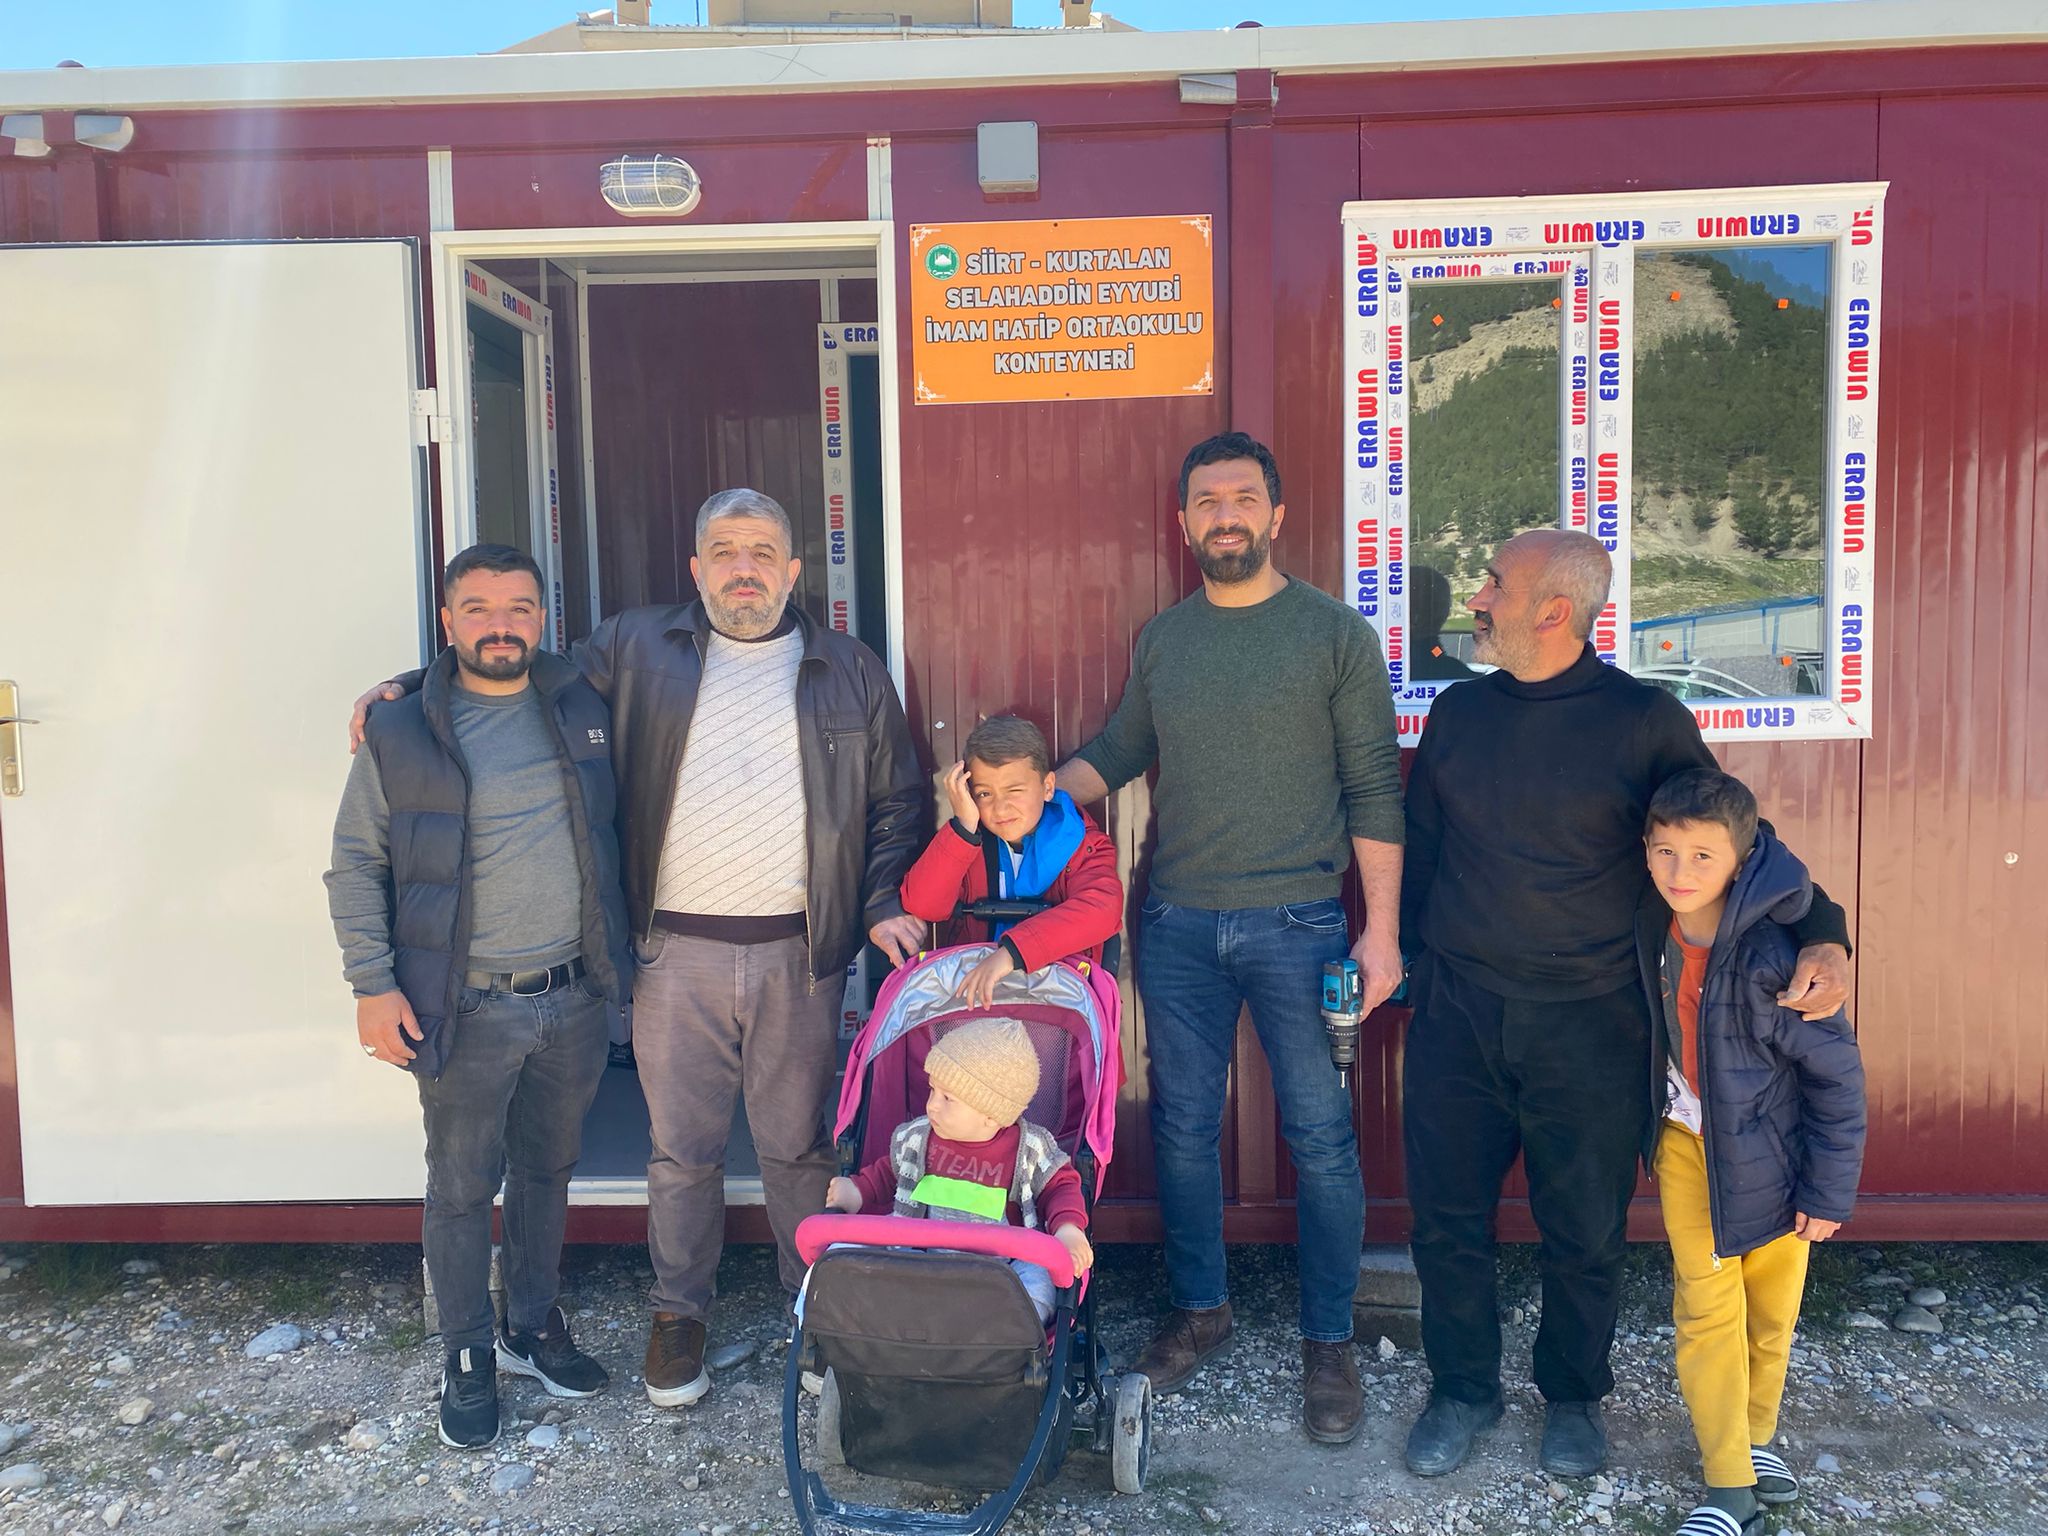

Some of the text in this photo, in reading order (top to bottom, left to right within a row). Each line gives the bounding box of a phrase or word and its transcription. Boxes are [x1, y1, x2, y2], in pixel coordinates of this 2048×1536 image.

[1046, 247, 1170, 272] KURTALAN
[1393, 226, 1493, 249] ERAWIN
[1544, 220, 1645, 243] ERAWIN
[1698, 214, 1800, 238] ERAWIN
[464, 269, 487, 296] AWIN
[945, 275, 1181, 309] SELAHADDİN EYYUBİ
[1412, 263, 1481, 279] ERAWIN
[502, 291, 532, 322] ERAWIN
[844, 327, 878, 342] ERA
[925, 312, 1203, 342] İMAM HATİP ORTAOKULU
[994, 343, 1135, 374] KONTEYNERİ
[1388, 325, 1403, 395] ERAWIN
[1599, 300, 1620, 401] ERAWIN
[1847, 299, 1870, 401] ERAWIN
[825, 387, 841, 458] ERAWIN
[1358, 368, 1378, 468] ERAWIN
[1572, 355, 1587, 425] ERAWIN
[1388, 427, 1403, 496] ERAWIN
[1571, 457, 1586, 526] ERAWIN
[829, 494, 845, 565] ERAWIN
[1843, 452, 1866, 553] ERAWIN
[1358, 519, 1378, 616] ERAWIN
[1388, 527, 1403, 595] ERAWIN
[1841, 604, 1863, 704] ERAWIN
[936, 1145, 1005, 1186] TEAM
